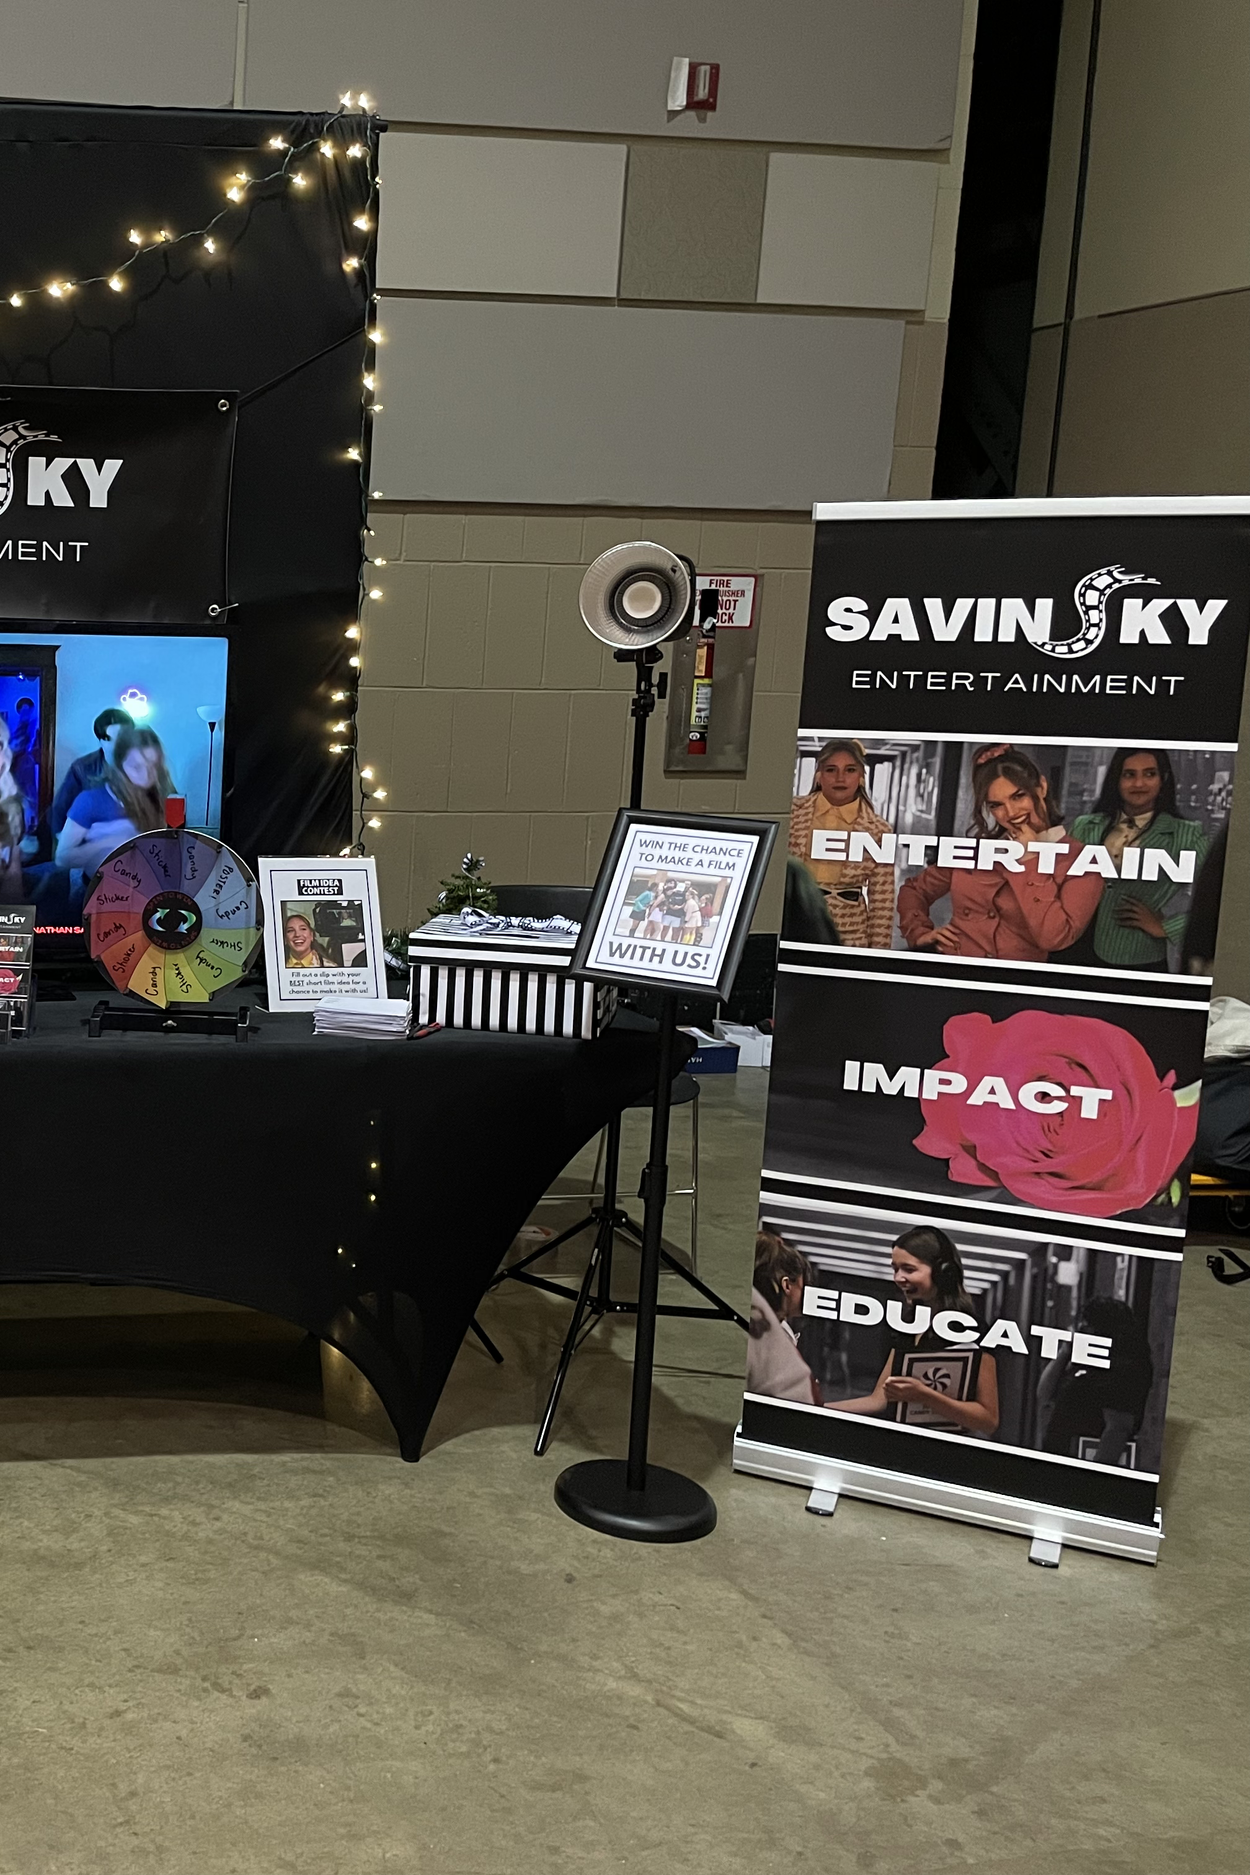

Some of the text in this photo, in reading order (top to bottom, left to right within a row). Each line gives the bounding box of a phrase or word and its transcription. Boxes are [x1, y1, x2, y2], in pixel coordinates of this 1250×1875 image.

[709, 578, 732, 588] FIRE
[718, 598, 739, 611] NOT
[825, 564, 1229, 659] SAVINSKY
[852, 670, 1185, 696] ENTERTAINMENT
[149, 844, 171, 878] Sticker
[638, 852, 736, 871] TO MAKE A FILM
[639, 839, 744, 858] WIN THE CHANCE
[810, 829, 1197, 884] ENTERTAIN
[114, 860, 142, 889] Candy
[184, 846, 198, 881] Candy
[209, 865, 234, 900] POSTER!
[300, 879, 340, 887] FILM IDEA
[302, 887, 339, 895] CONTEST
[96, 894, 131, 906] Sticker
[216, 900, 249, 920] Candy
[97, 922, 127, 943] Candy
[196, 950, 223, 979] Candy
[608, 941, 711, 971] WITH US!
[145, 966, 162, 996] Candy
[172, 963, 192, 994] Sticker
[843, 1060, 1113, 1120] IMPACT
[802, 1285, 1113, 1370] EDUCATE
